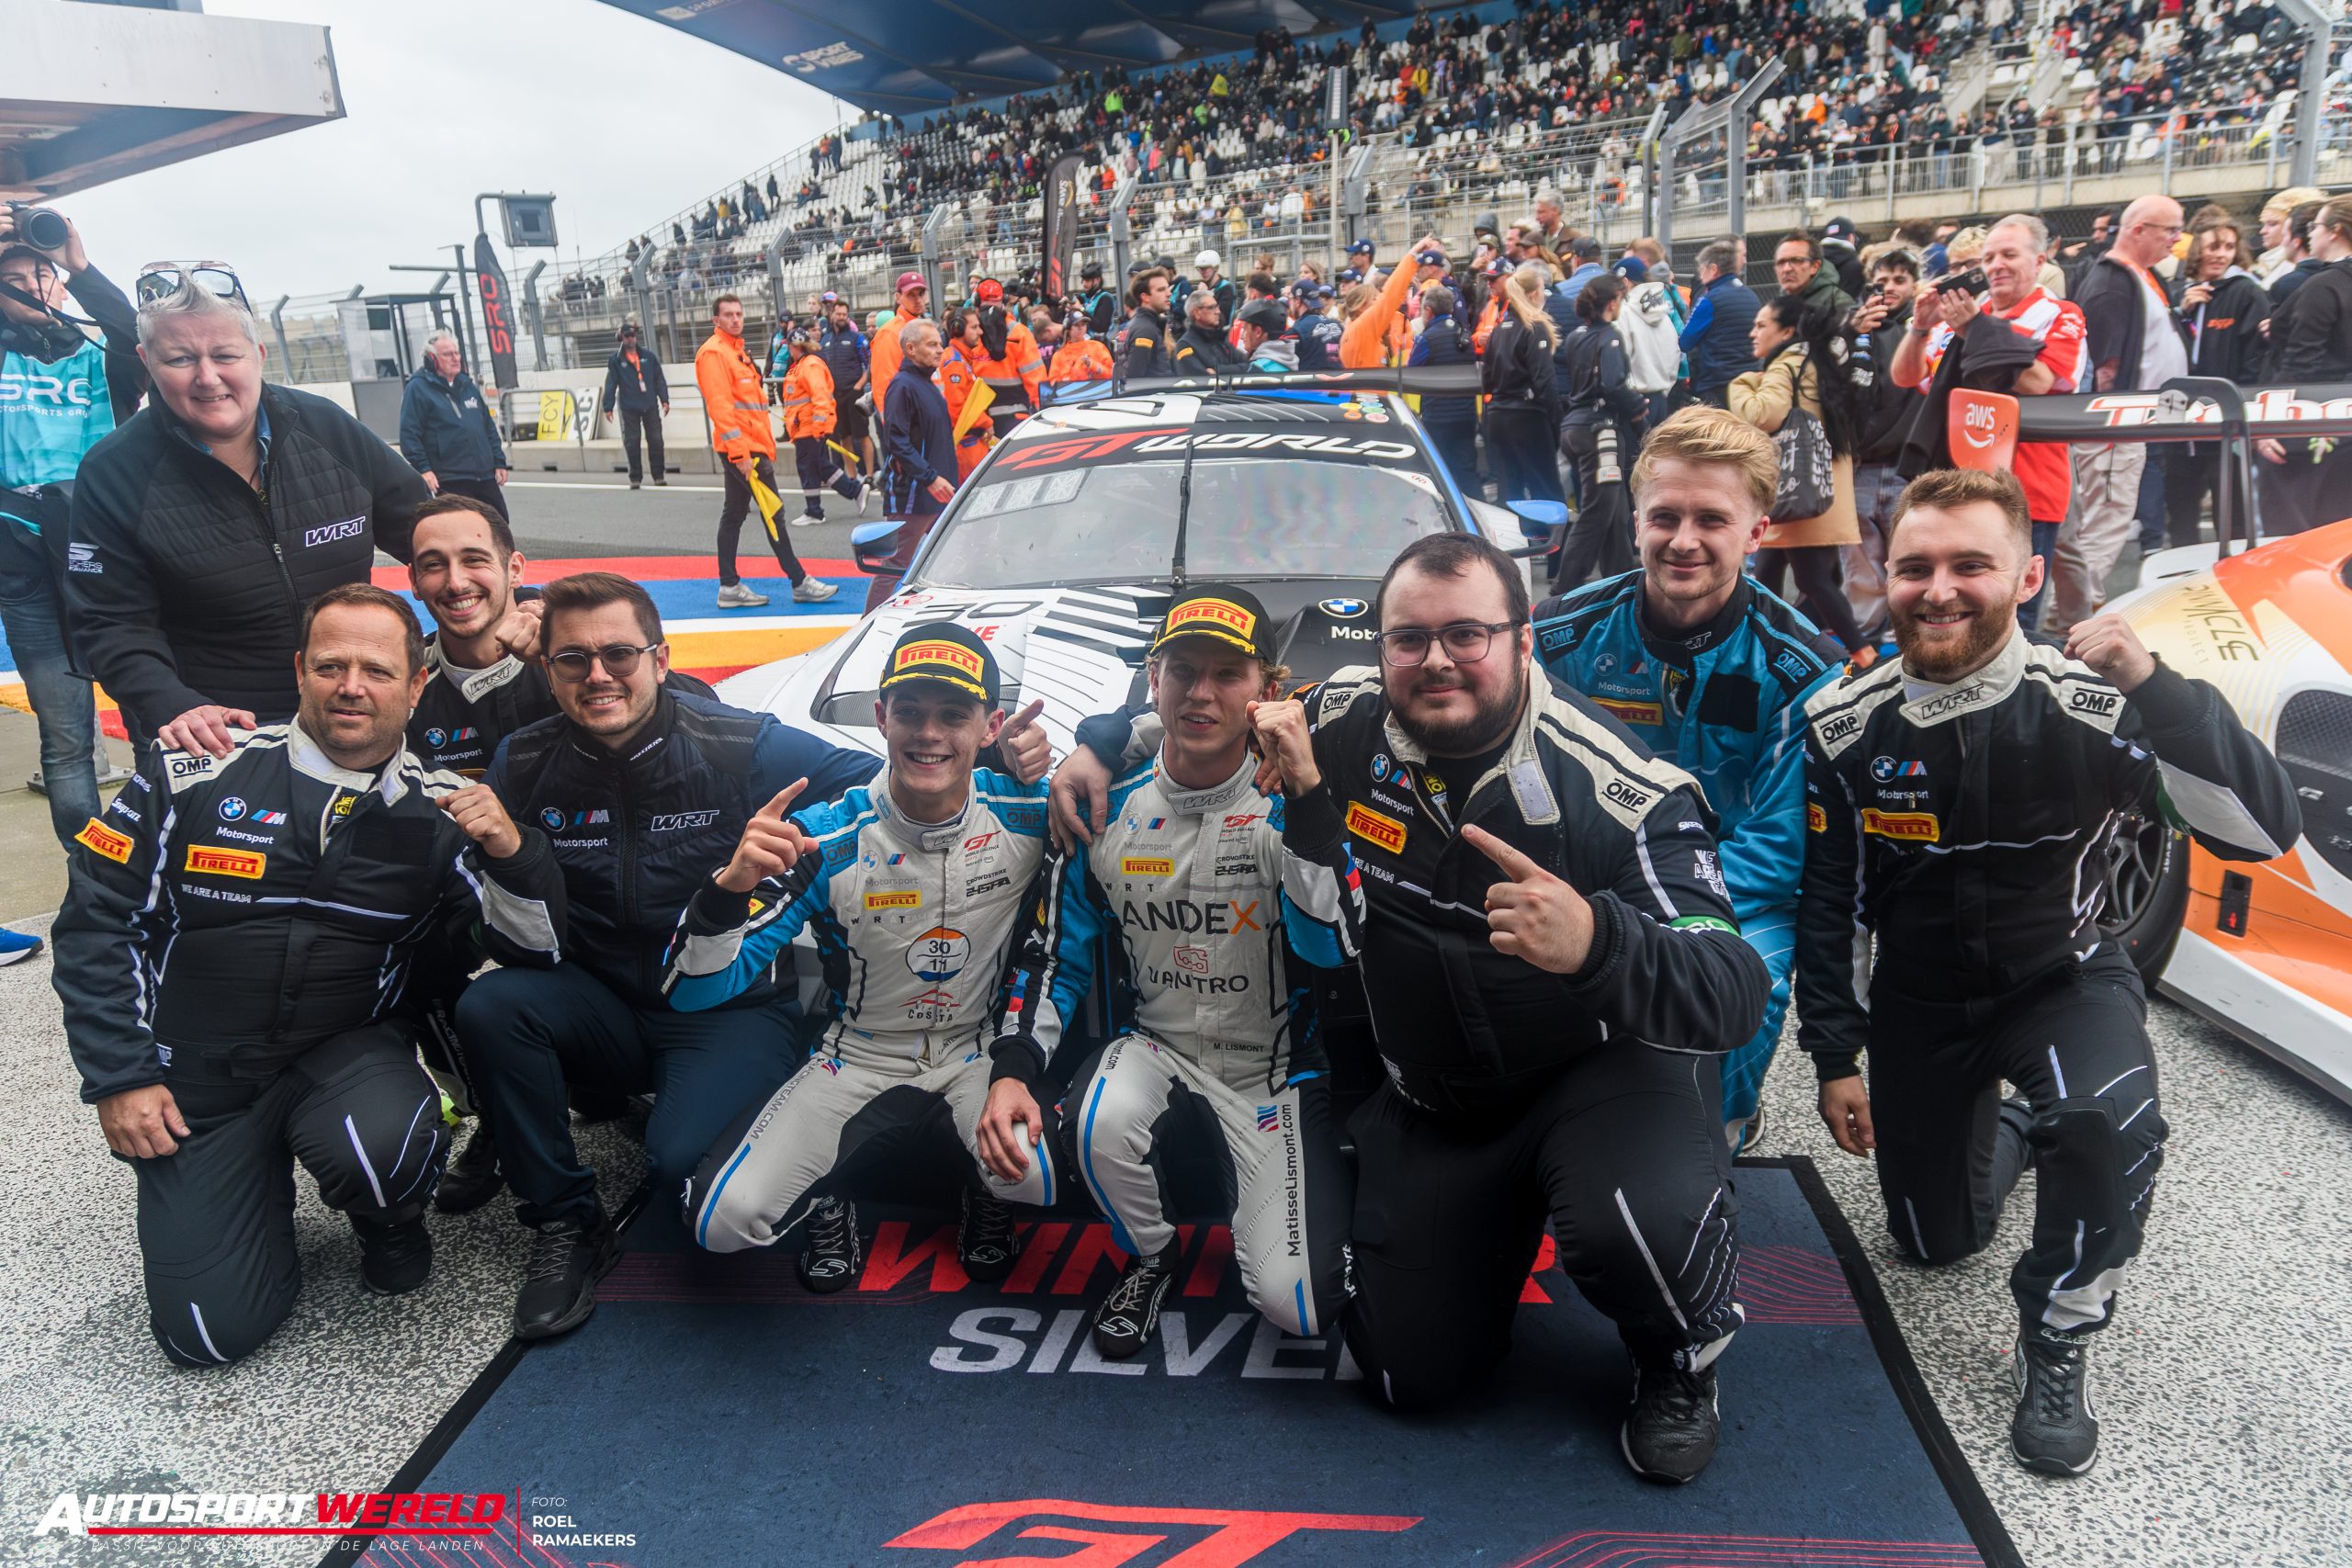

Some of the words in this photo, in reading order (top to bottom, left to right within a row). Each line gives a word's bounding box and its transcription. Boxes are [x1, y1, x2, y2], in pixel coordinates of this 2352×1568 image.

[480, 273, 512, 355] SRO
[541, 395, 560, 434] FCY
[573, 395, 594, 432] SC
[1965, 402, 1996, 430] aws
[995, 428, 1191, 469] GT
[1133, 434, 1417, 459] WORLD
[306, 516, 366, 547] WRT
[901, 601, 1045, 629] 30
[1170, 603, 1250, 630] PIRELLI
[1543, 628, 1575, 648] OMP
[900, 644, 978, 673] PIRELLI
[1776, 652, 1807, 679] OMP
[470, 663, 512, 695] WRT
[1598, 682, 1651, 696] Motorsport
[1324, 694, 1351, 710] OMP
[1922, 684, 1984, 719] WRT
[2072, 692, 2117, 712] OMP
[1824, 716, 1859, 740] OMP
[434, 749, 484, 762] Motorsport
[173, 758, 212, 774] OMP
[1183, 789, 1236, 809] WRT
[1371, 789, 1415, 817] Motorsport
[1607, 783, 1647, 808] OMP
[650, 809, 720, 831] WRT
[1007, 810, 1042, 824] OMP
[1224, 814, 1267, 828] GT
[1869, 813, 1932, 835] PIRELLI
[216, 826, 275, 845] Motorsport
[1350, 808, 1402, 847] PIRELLI
[83, 825, 128, 857] PIRELLI
[553, 837, 608, 849] Motorsport
[964, 829, 1001, 852] GT
[1124, 841, 1172, 852] Motorsport
[192, 851, 259, 874] PIRELLI
[827, 843, 856, 863] OMP
[1125, 860, 1170, 873] PIRELLI
[1371, 865, 1395, 884] TEAM
[865, 877, 919, 888] Motorsport
[967, 868, 1007, 886] CROWDSTRIKE
[181, 884, 192, 893] WE
[192, 886, 211, 897] ARE
[213, 890, 220, 900] A
[221, 891, 252, 904] TEAM
[868, 894, 917, 908] PIRELLI
[929, 940, 951, 954] 30
[930, 958, 947, 972] 11
[908, 1009, 953, 1023] COSTA
[158, 1047, 172, 1063] MP
[1214, 1043, 1223, 1051] M.
[1225, 1044, 1265, 1053] LISMONT
[1282, 1103, 1302, 1258] MatisseLismont.com
[1140, 1258, 1160, 1267] OMP
[929, 1307, 1363, 1382] SILVE
